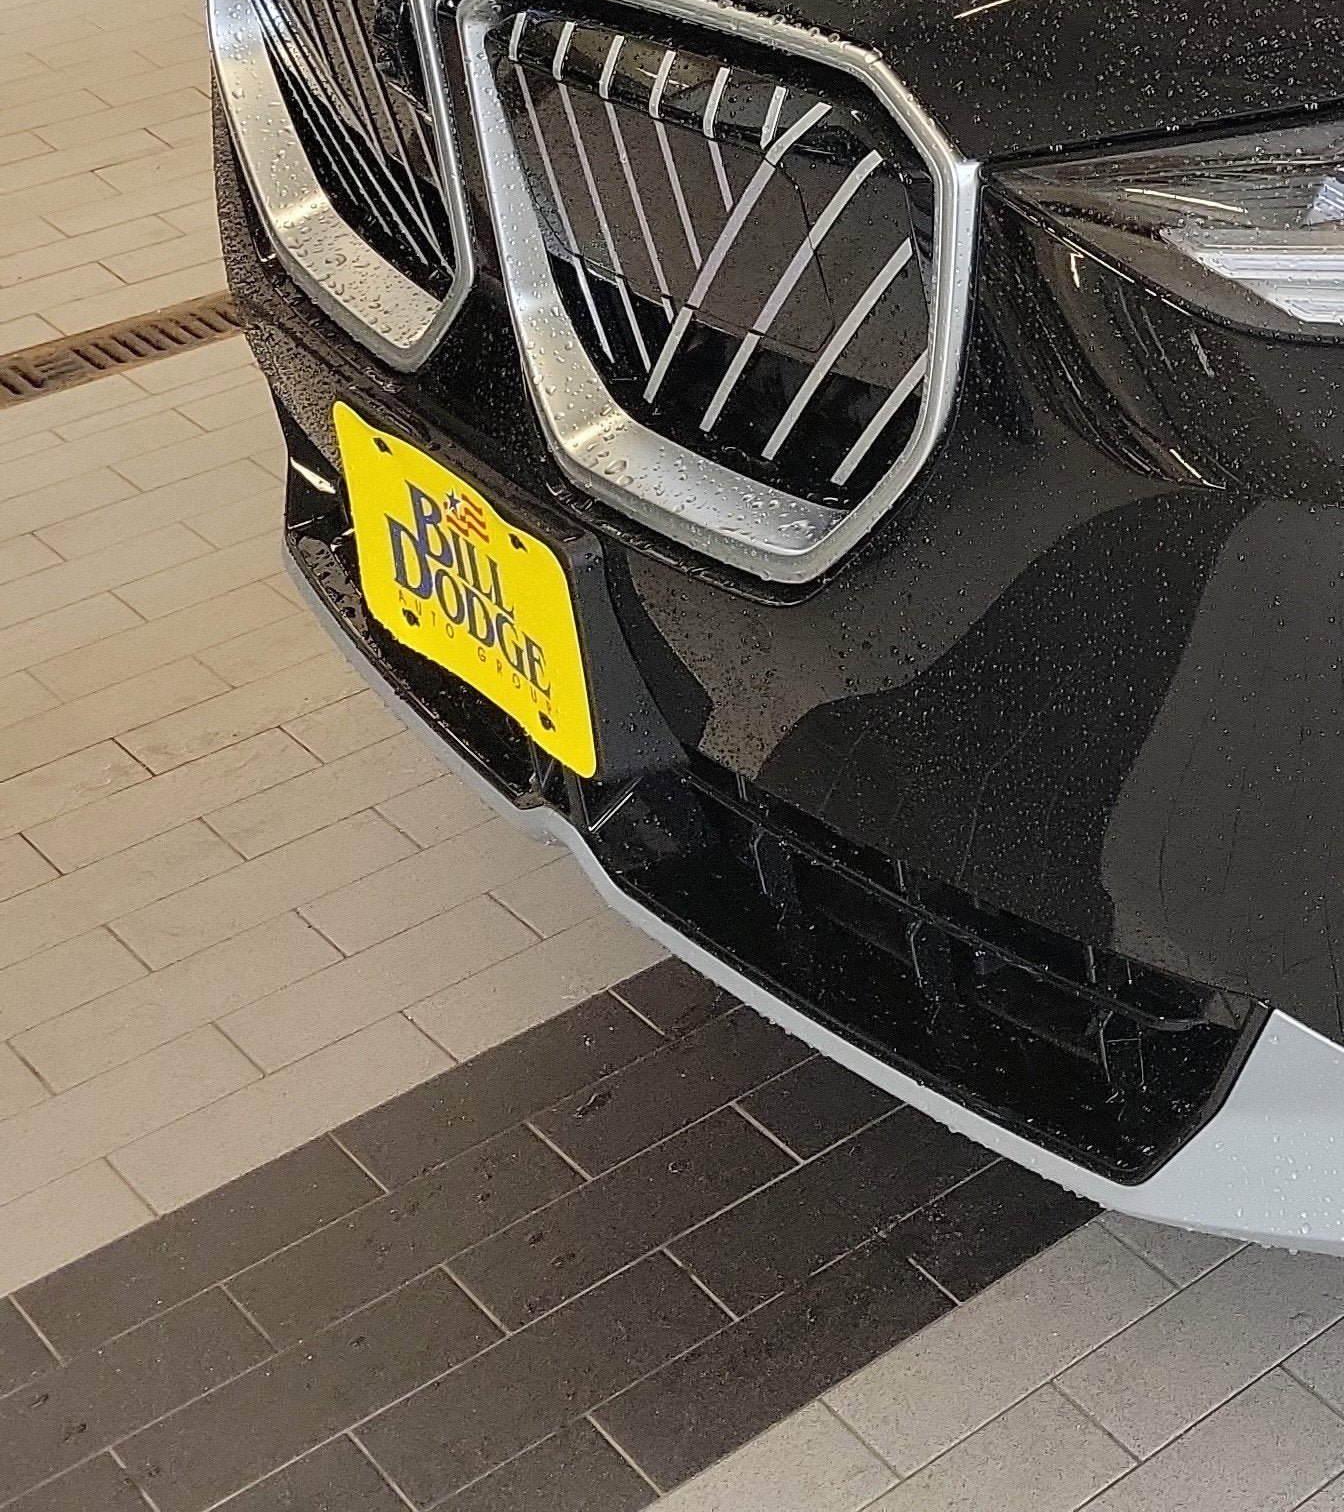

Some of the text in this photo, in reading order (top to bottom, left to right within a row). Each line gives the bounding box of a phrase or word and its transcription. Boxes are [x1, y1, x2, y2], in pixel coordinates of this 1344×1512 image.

[383, 512, 551, 700] DODGE
[398, 589, 455, 639] AUTO
[404, 478, 516, 623] BILL
